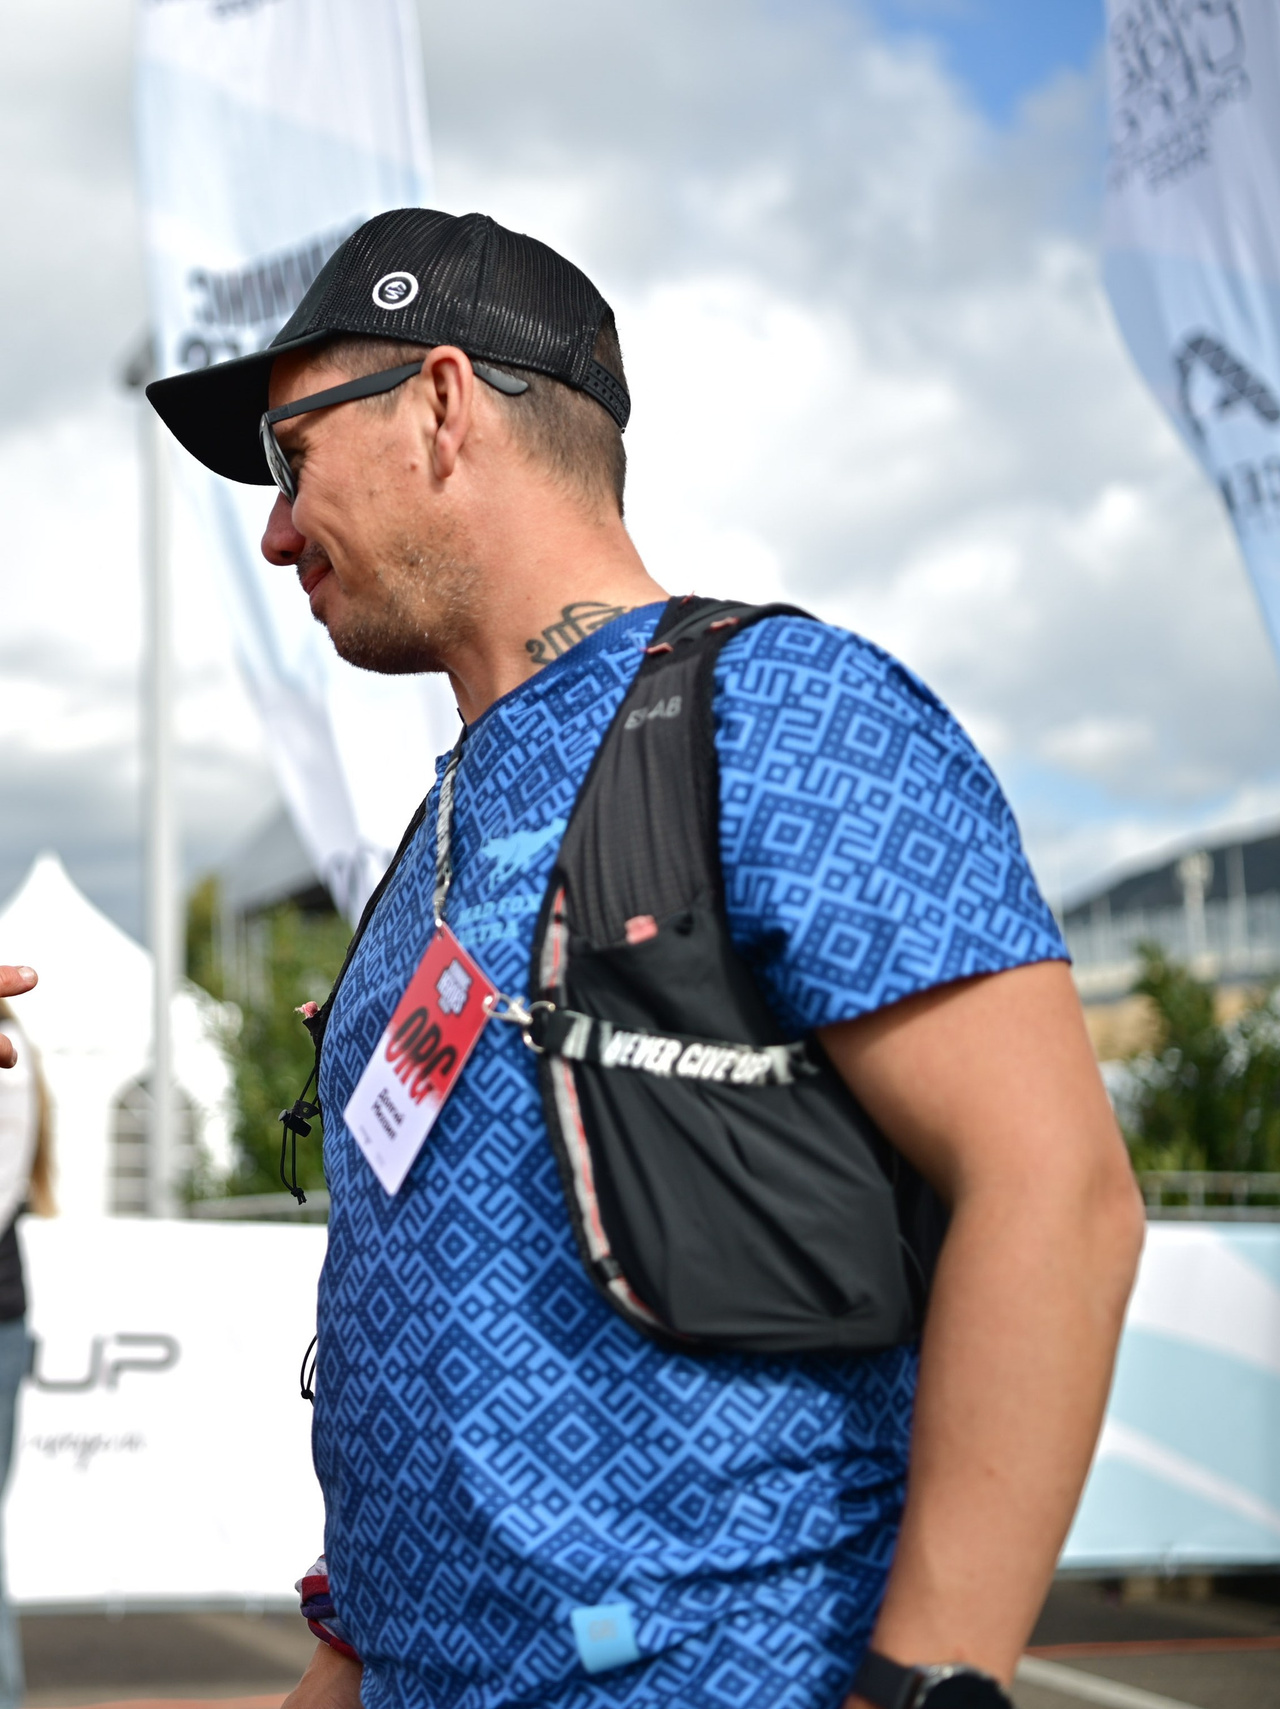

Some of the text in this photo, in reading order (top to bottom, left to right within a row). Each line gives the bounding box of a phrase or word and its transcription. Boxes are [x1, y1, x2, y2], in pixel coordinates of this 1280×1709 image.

[384, 1006, 457, 1105] ORG
[602, 1031, 683, 1077] NEVER
[676, 1043, 737, 1081] GIVE
